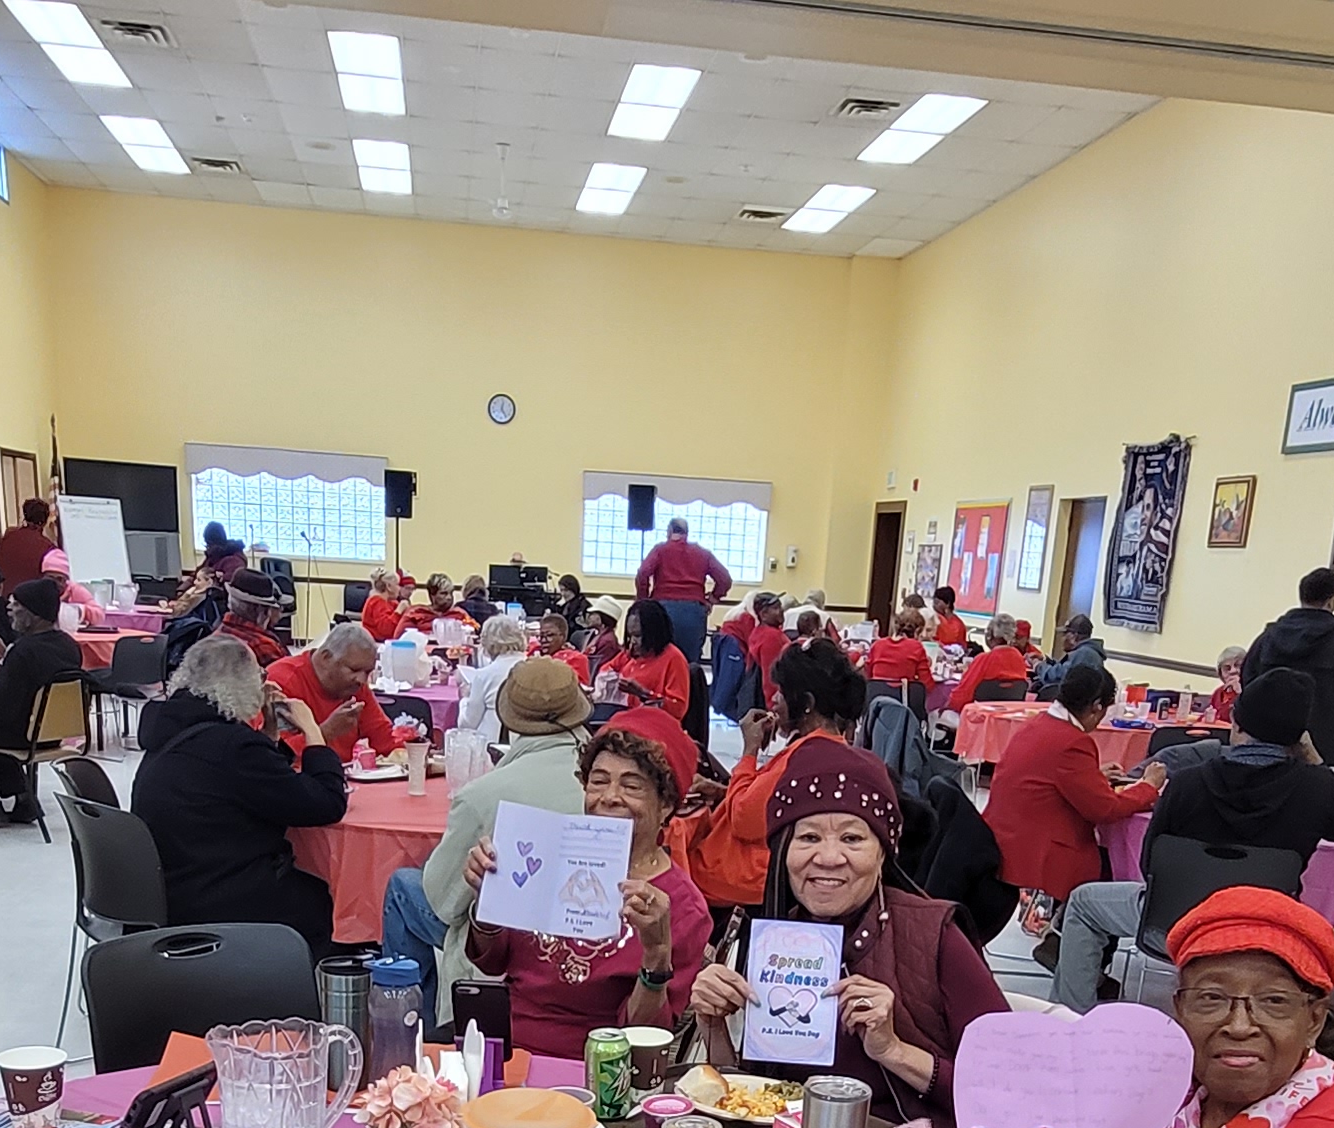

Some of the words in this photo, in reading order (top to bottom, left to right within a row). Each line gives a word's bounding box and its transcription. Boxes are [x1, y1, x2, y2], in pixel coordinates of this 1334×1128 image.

[768, 953, 823, 970] Spread
[759, 969, 829, 987] Kindness
[807, 1030, 820, 1039] Day
